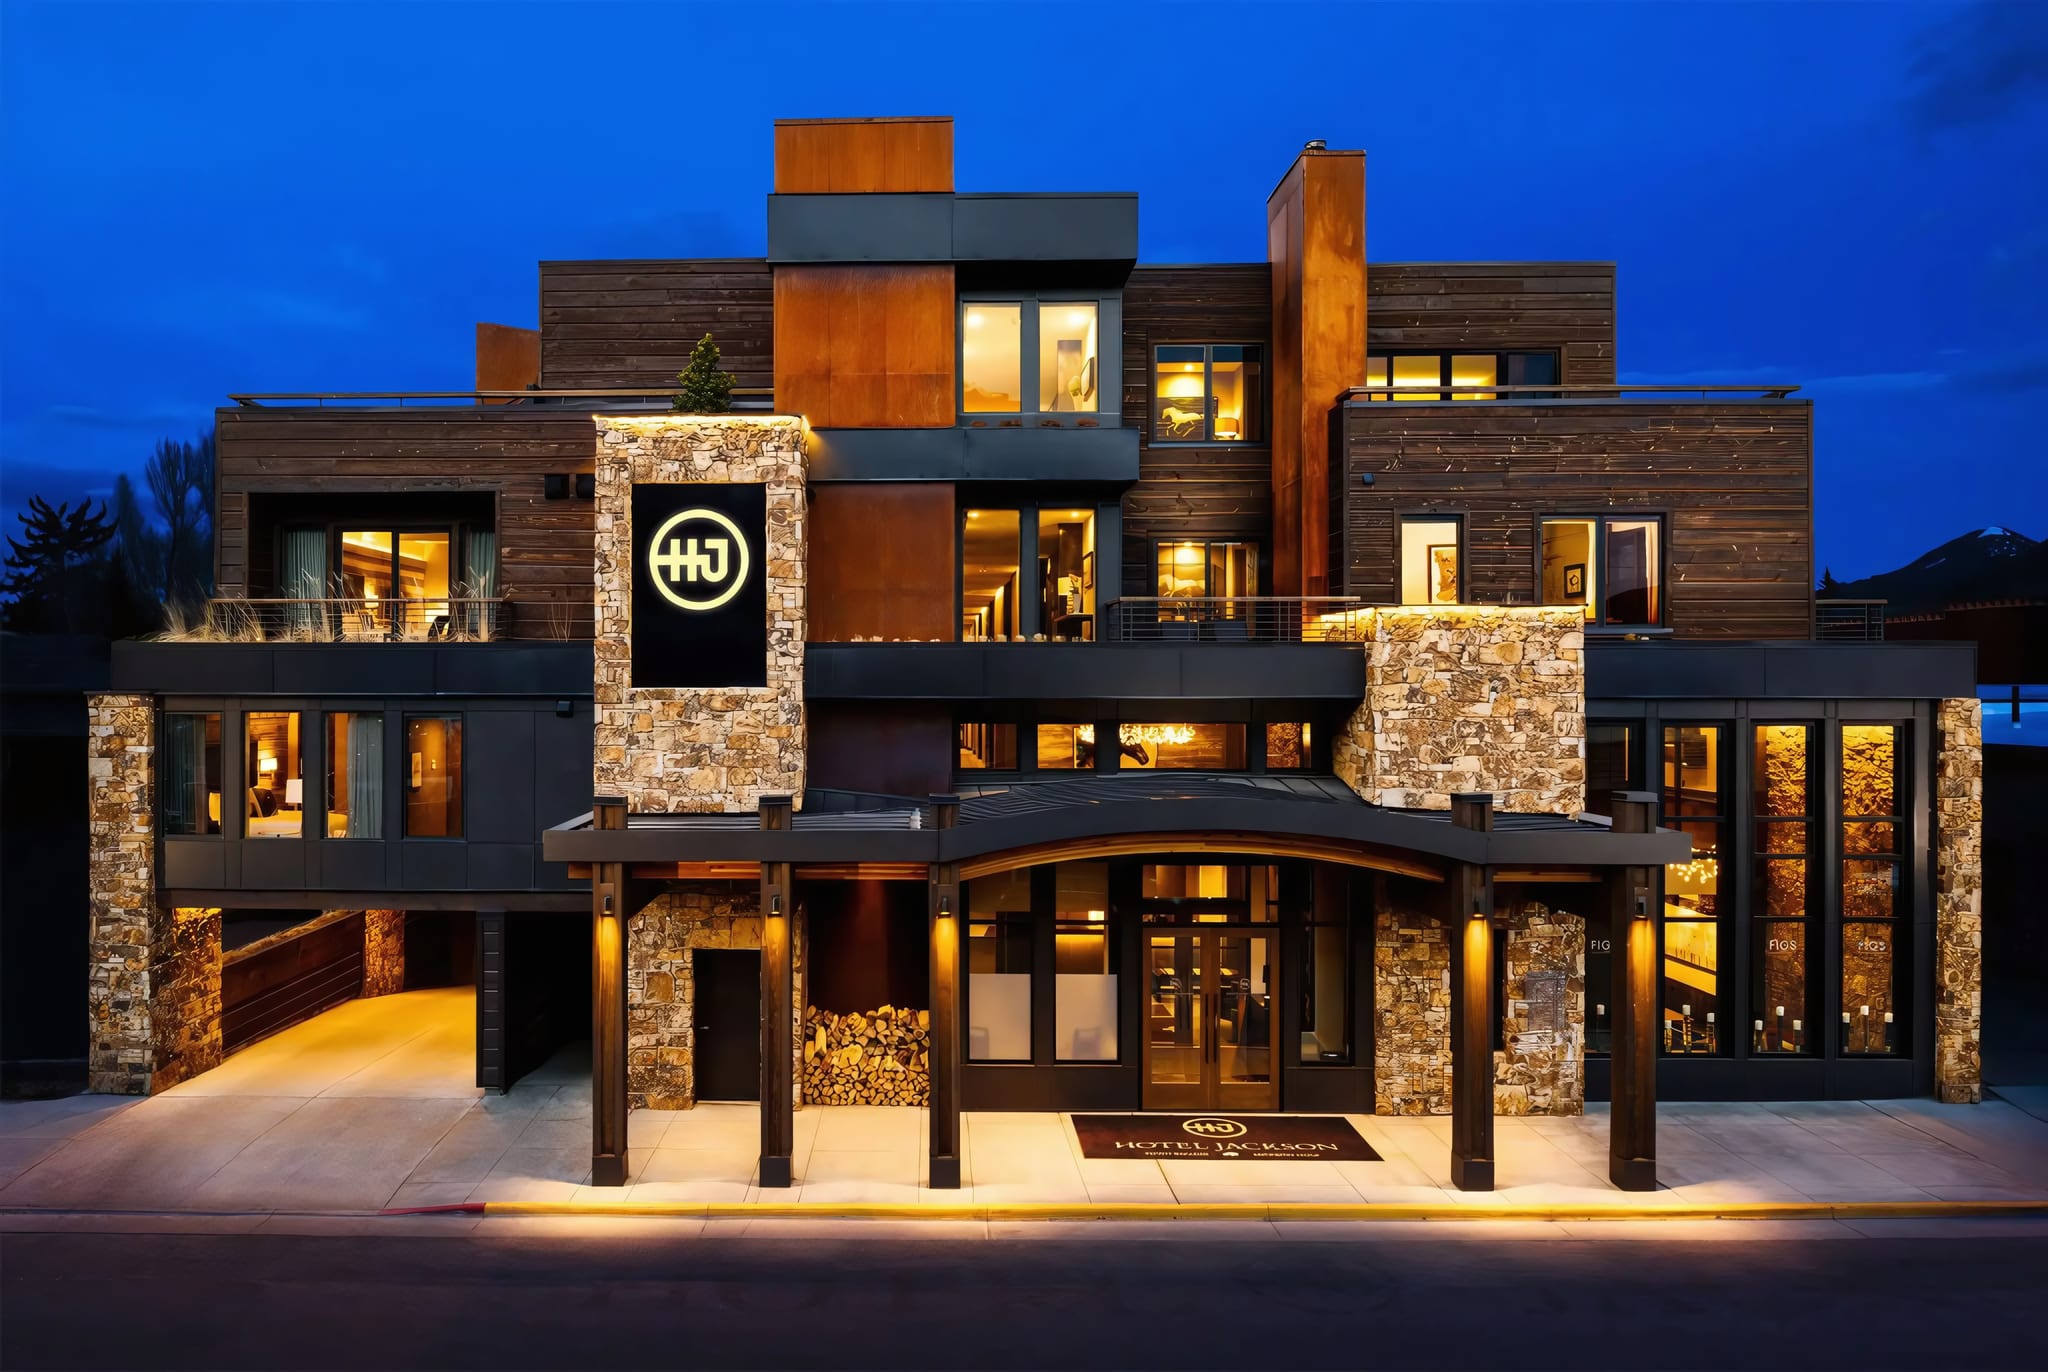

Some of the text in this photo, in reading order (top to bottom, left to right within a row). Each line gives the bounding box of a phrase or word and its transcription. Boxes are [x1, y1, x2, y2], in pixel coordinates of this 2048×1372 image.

[664, 538, 729, 583] HJ
[1193, 1122, 1234, 1133] HJ
[1115, 1141, 1339, 1152] HOTEL JACKSON
